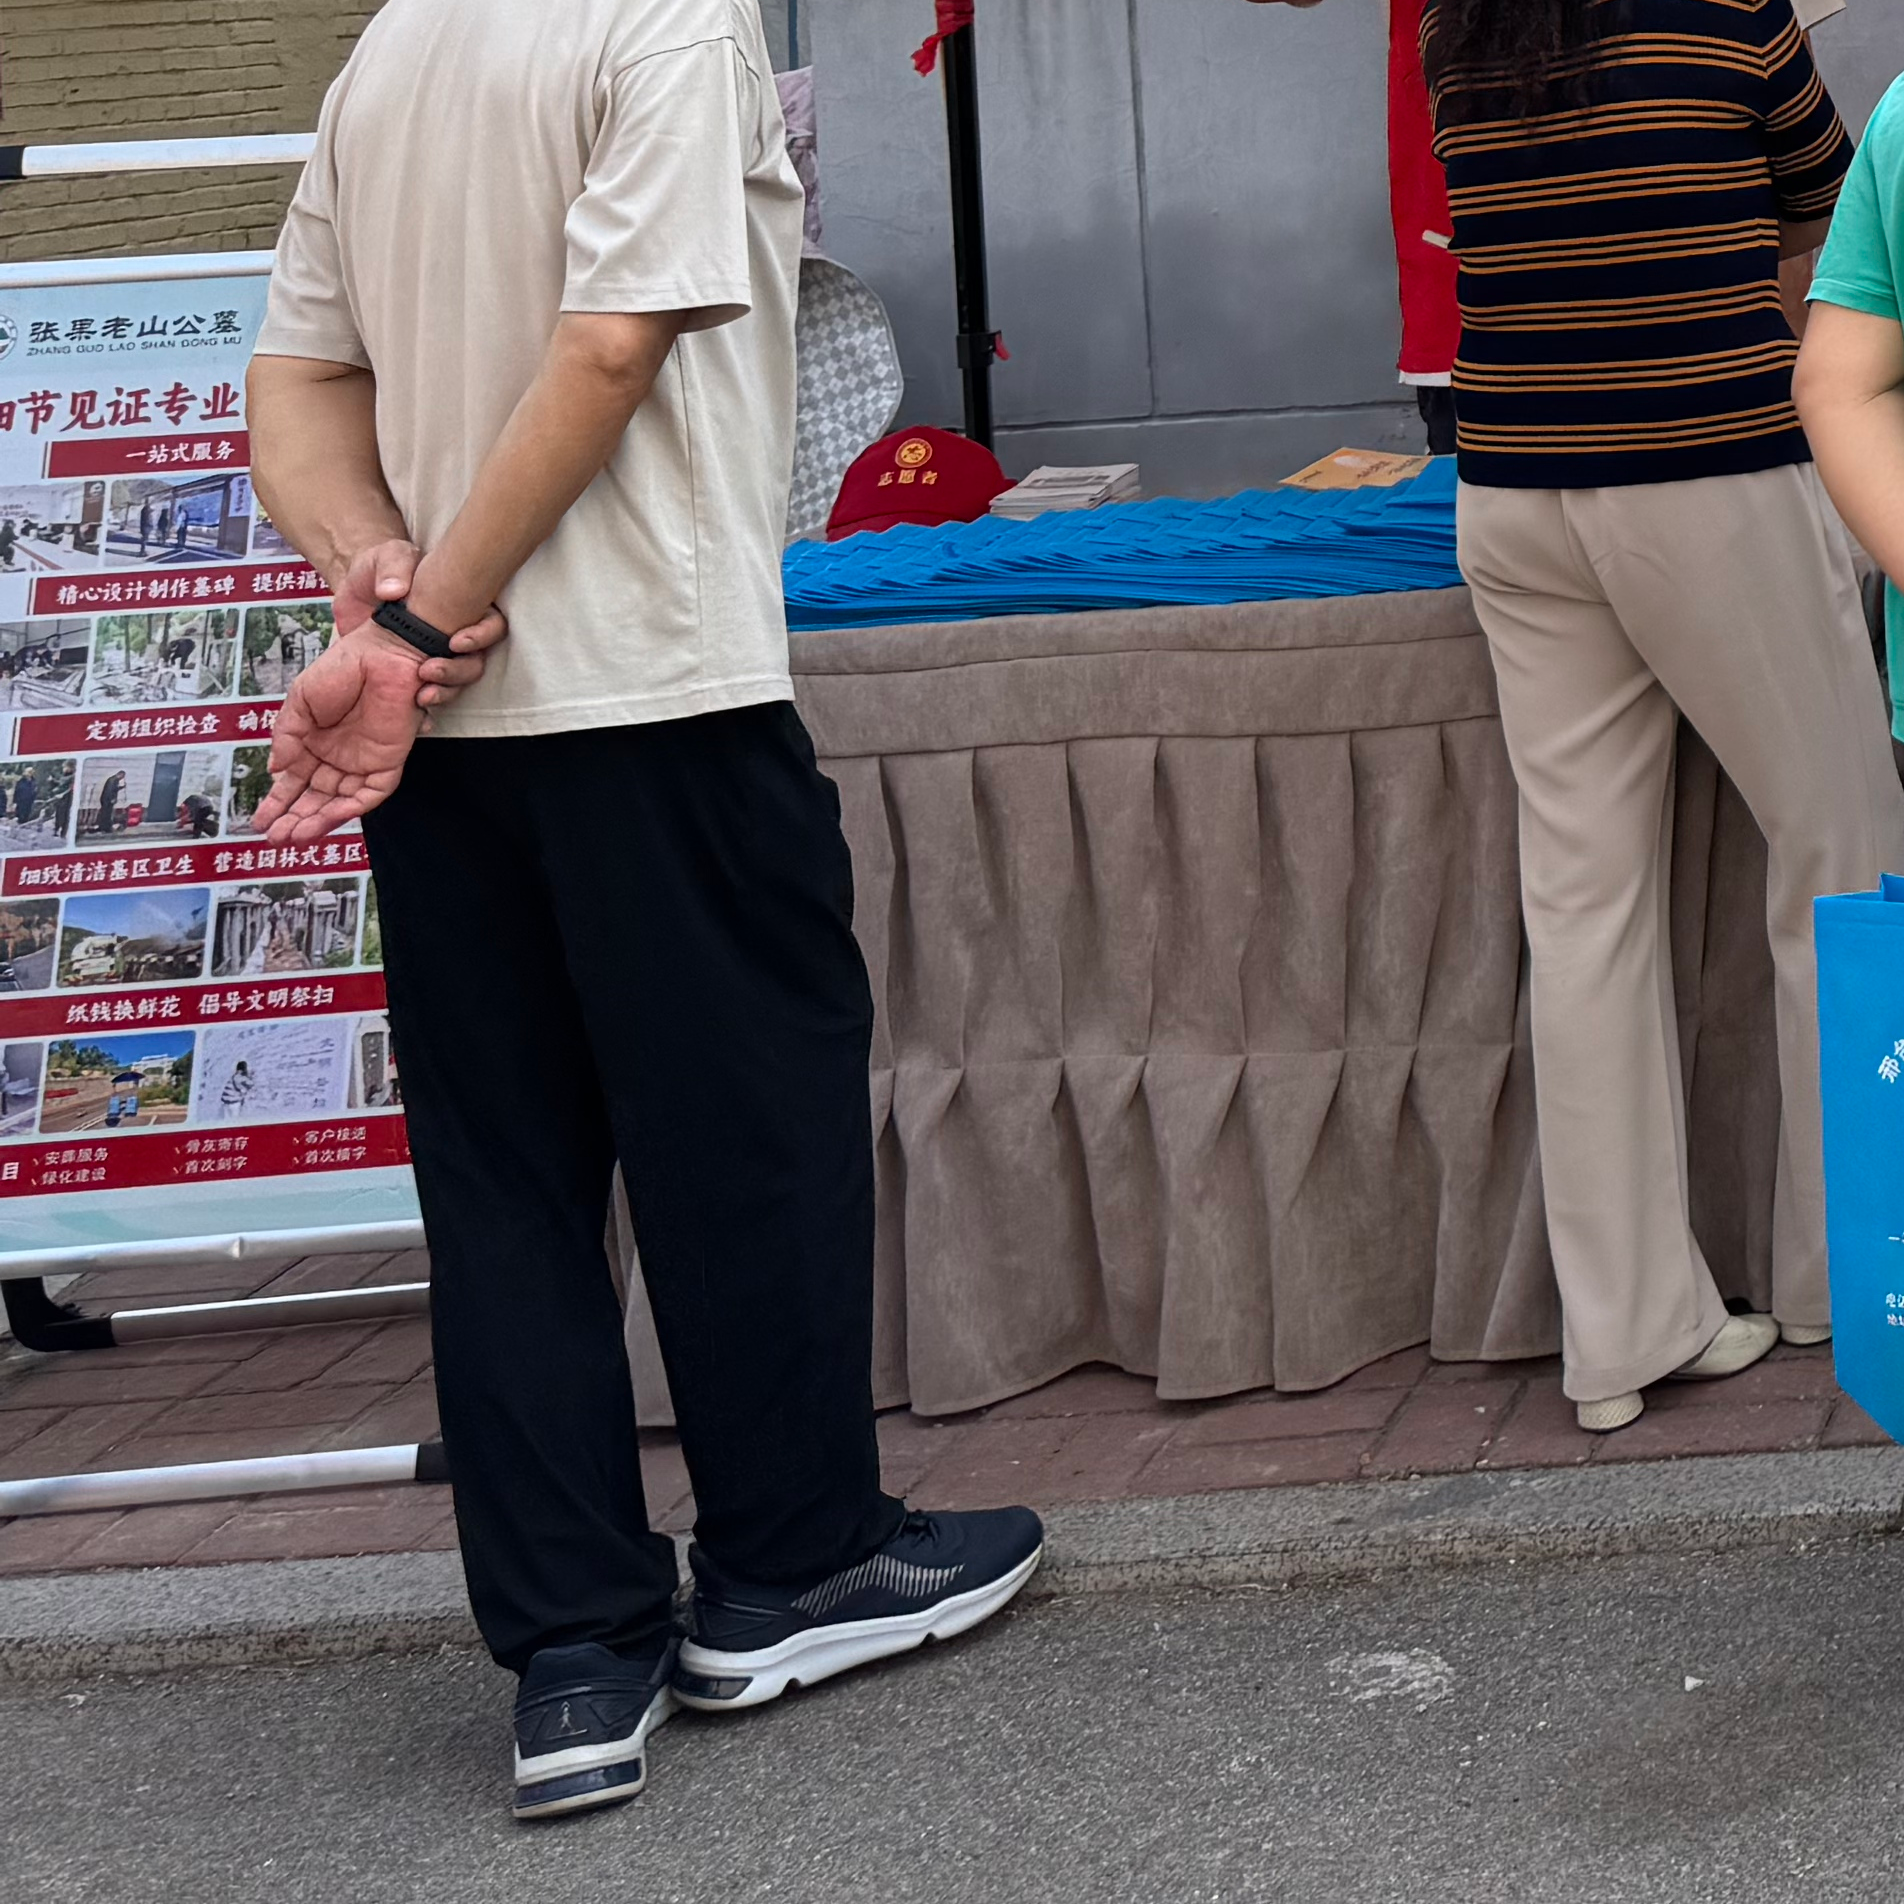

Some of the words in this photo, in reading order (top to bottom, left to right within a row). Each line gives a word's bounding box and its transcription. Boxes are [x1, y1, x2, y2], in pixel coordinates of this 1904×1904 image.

[28, 308, 243, 345] 张果老山公墓
[125, 439, 236, 464] 一站式服务
[85, 712, 221, 742] 定期组织检查
[212, 841, 369, 875] 营造园林式墓区
[65, 995, 182, 1025] 纸钱换鲜花
[196, 984, 335, 1015] 倡导文明祭扫
